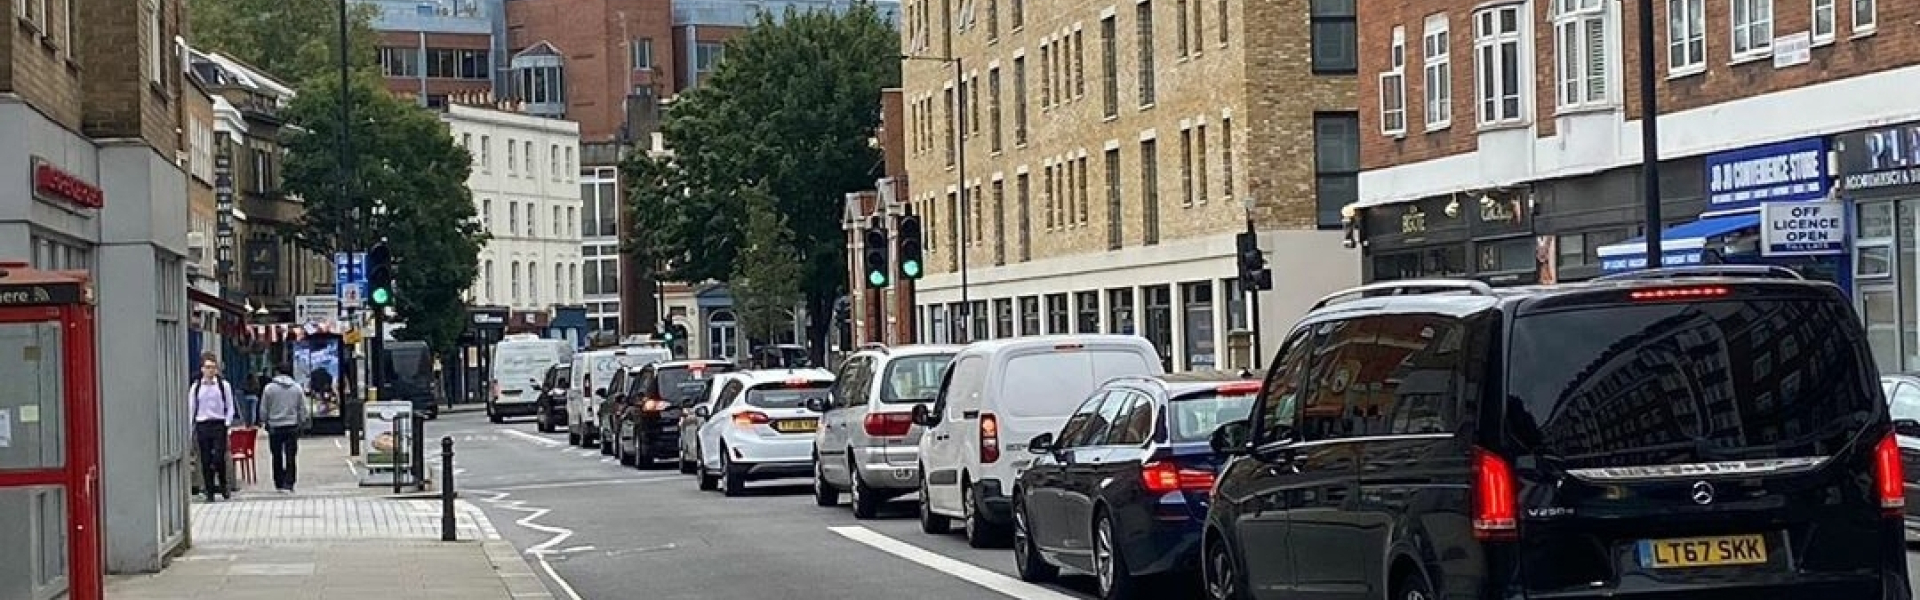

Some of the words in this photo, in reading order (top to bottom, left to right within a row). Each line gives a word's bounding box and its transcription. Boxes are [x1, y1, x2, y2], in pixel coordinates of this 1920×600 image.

[1733, 155, 1789, 188] CONVENIENCE
[1790, 150, 1820, 181] STORE
[1791, 206, 1821, 218] OFF
[1773, 218, 1839, 231] LICENCE
[1786, 231, 1829, 242] OPEN
[1653, 541, 1710, 564] LT67
[1719, 538, 1761, 561] SKK
